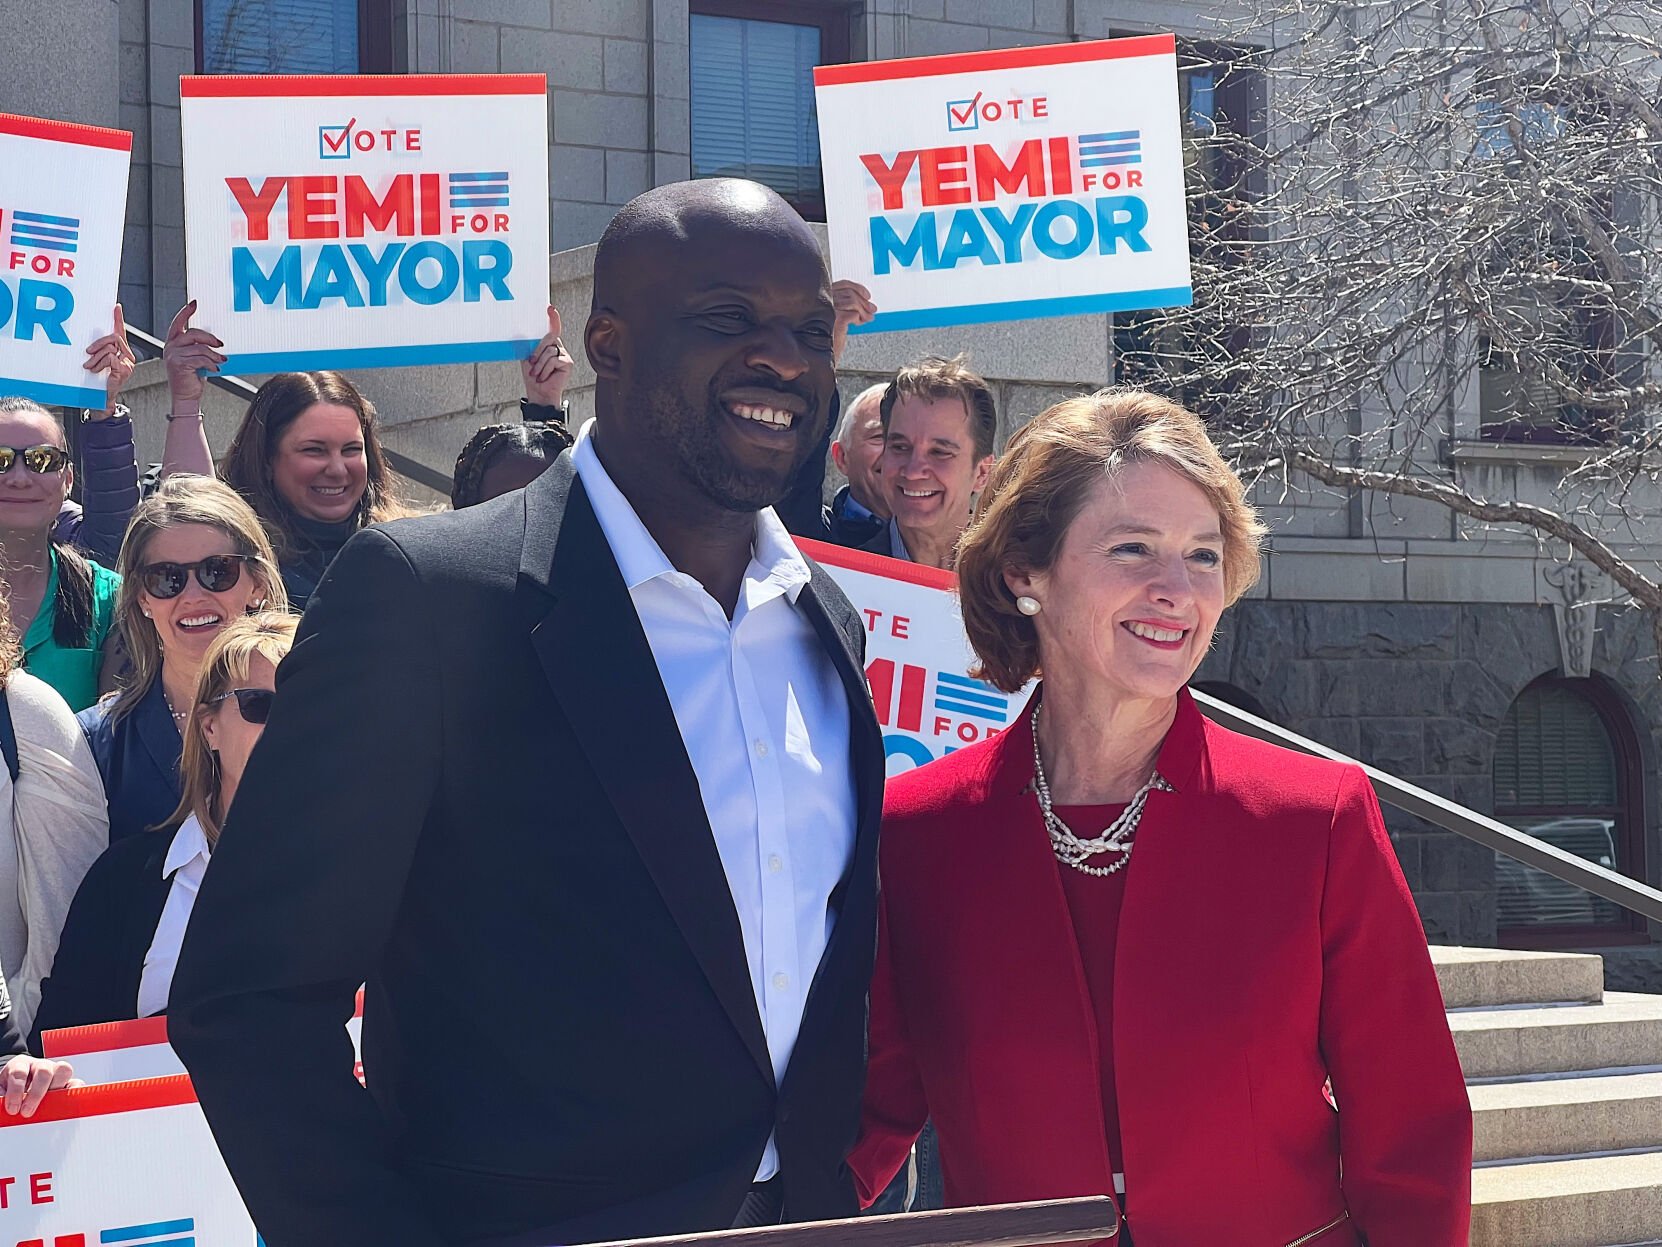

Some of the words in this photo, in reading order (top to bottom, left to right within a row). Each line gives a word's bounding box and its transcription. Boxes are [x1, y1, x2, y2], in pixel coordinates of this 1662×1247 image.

[859, 136, 1073, 210] YEMI
[1082, 170, 1143, 192] FOR
[225, 174, 441, 240] YEMI
[450, 213, 509, 234] FOR
[869, 195, 1152, 275] MAYOR
[9, 251, 75, 278] FOR
[232, 240, 514, 312] MAYOR
[863, 608, 910, 640] TE
[0, 1171, 54, 1209] TE
